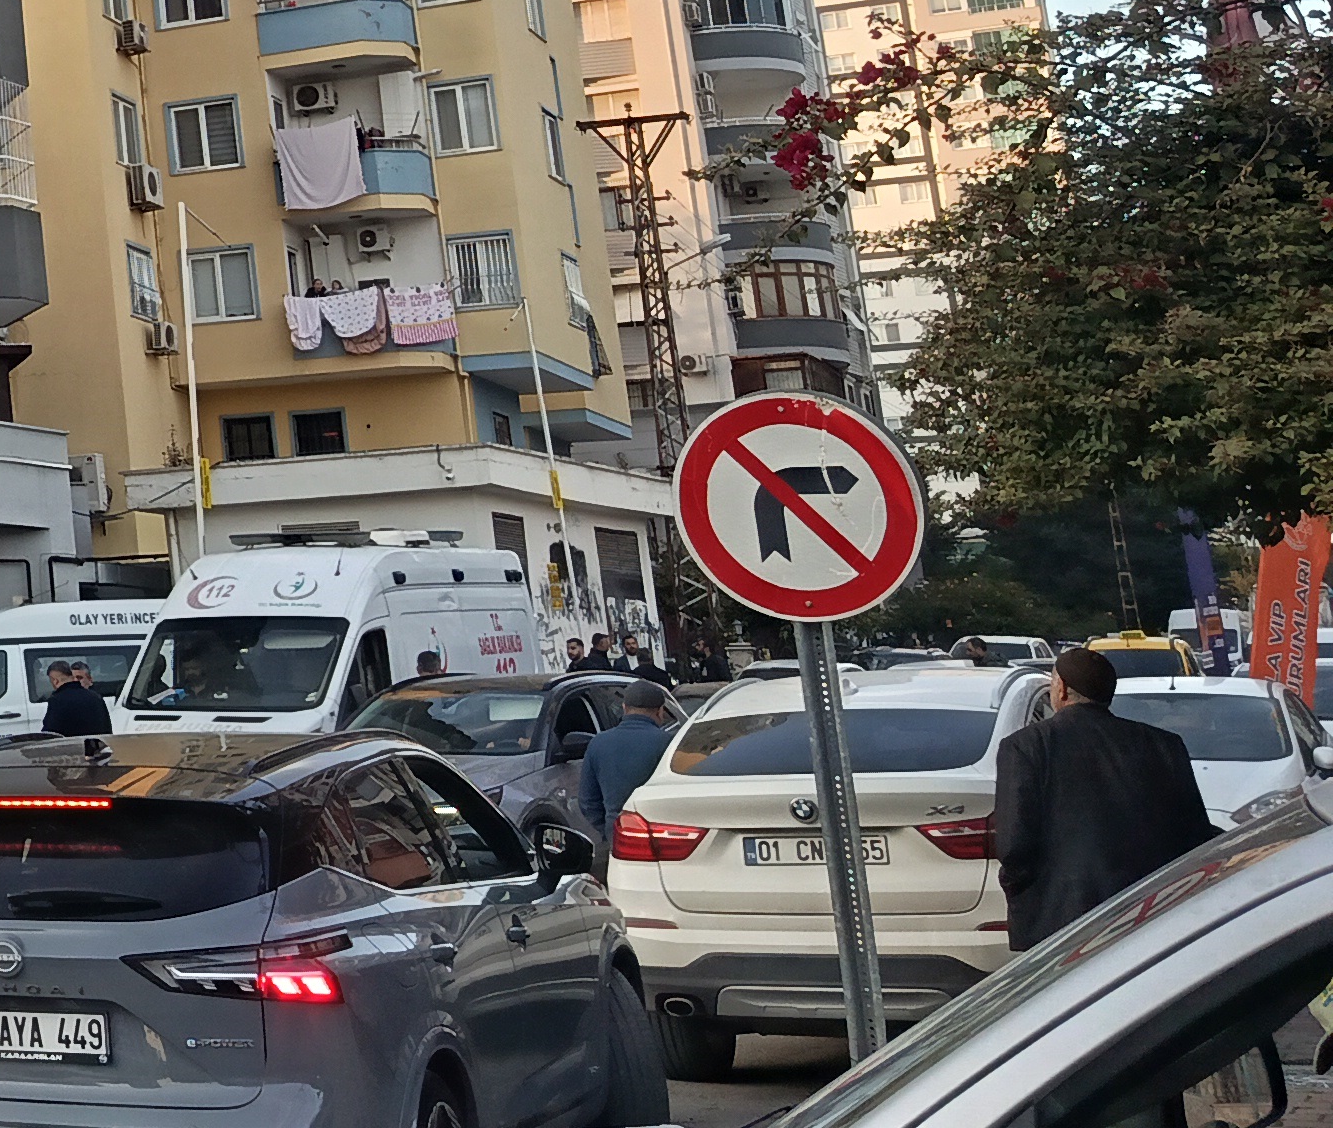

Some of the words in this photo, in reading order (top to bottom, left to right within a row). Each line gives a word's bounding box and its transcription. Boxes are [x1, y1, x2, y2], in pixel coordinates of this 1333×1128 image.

[205, 584, 236, 599] 112
[69, 613, 99, 626] OLAY
[1267, 599, 1287, 646] VIP
[1285, 557, 1312, 700] URUMLARI
[926, 803, 965, 817] X4
[757, 839, 781, 862] 01
[0, 1015, 44, 1048] AYA
[57, 1016, 103, 1050] 449
